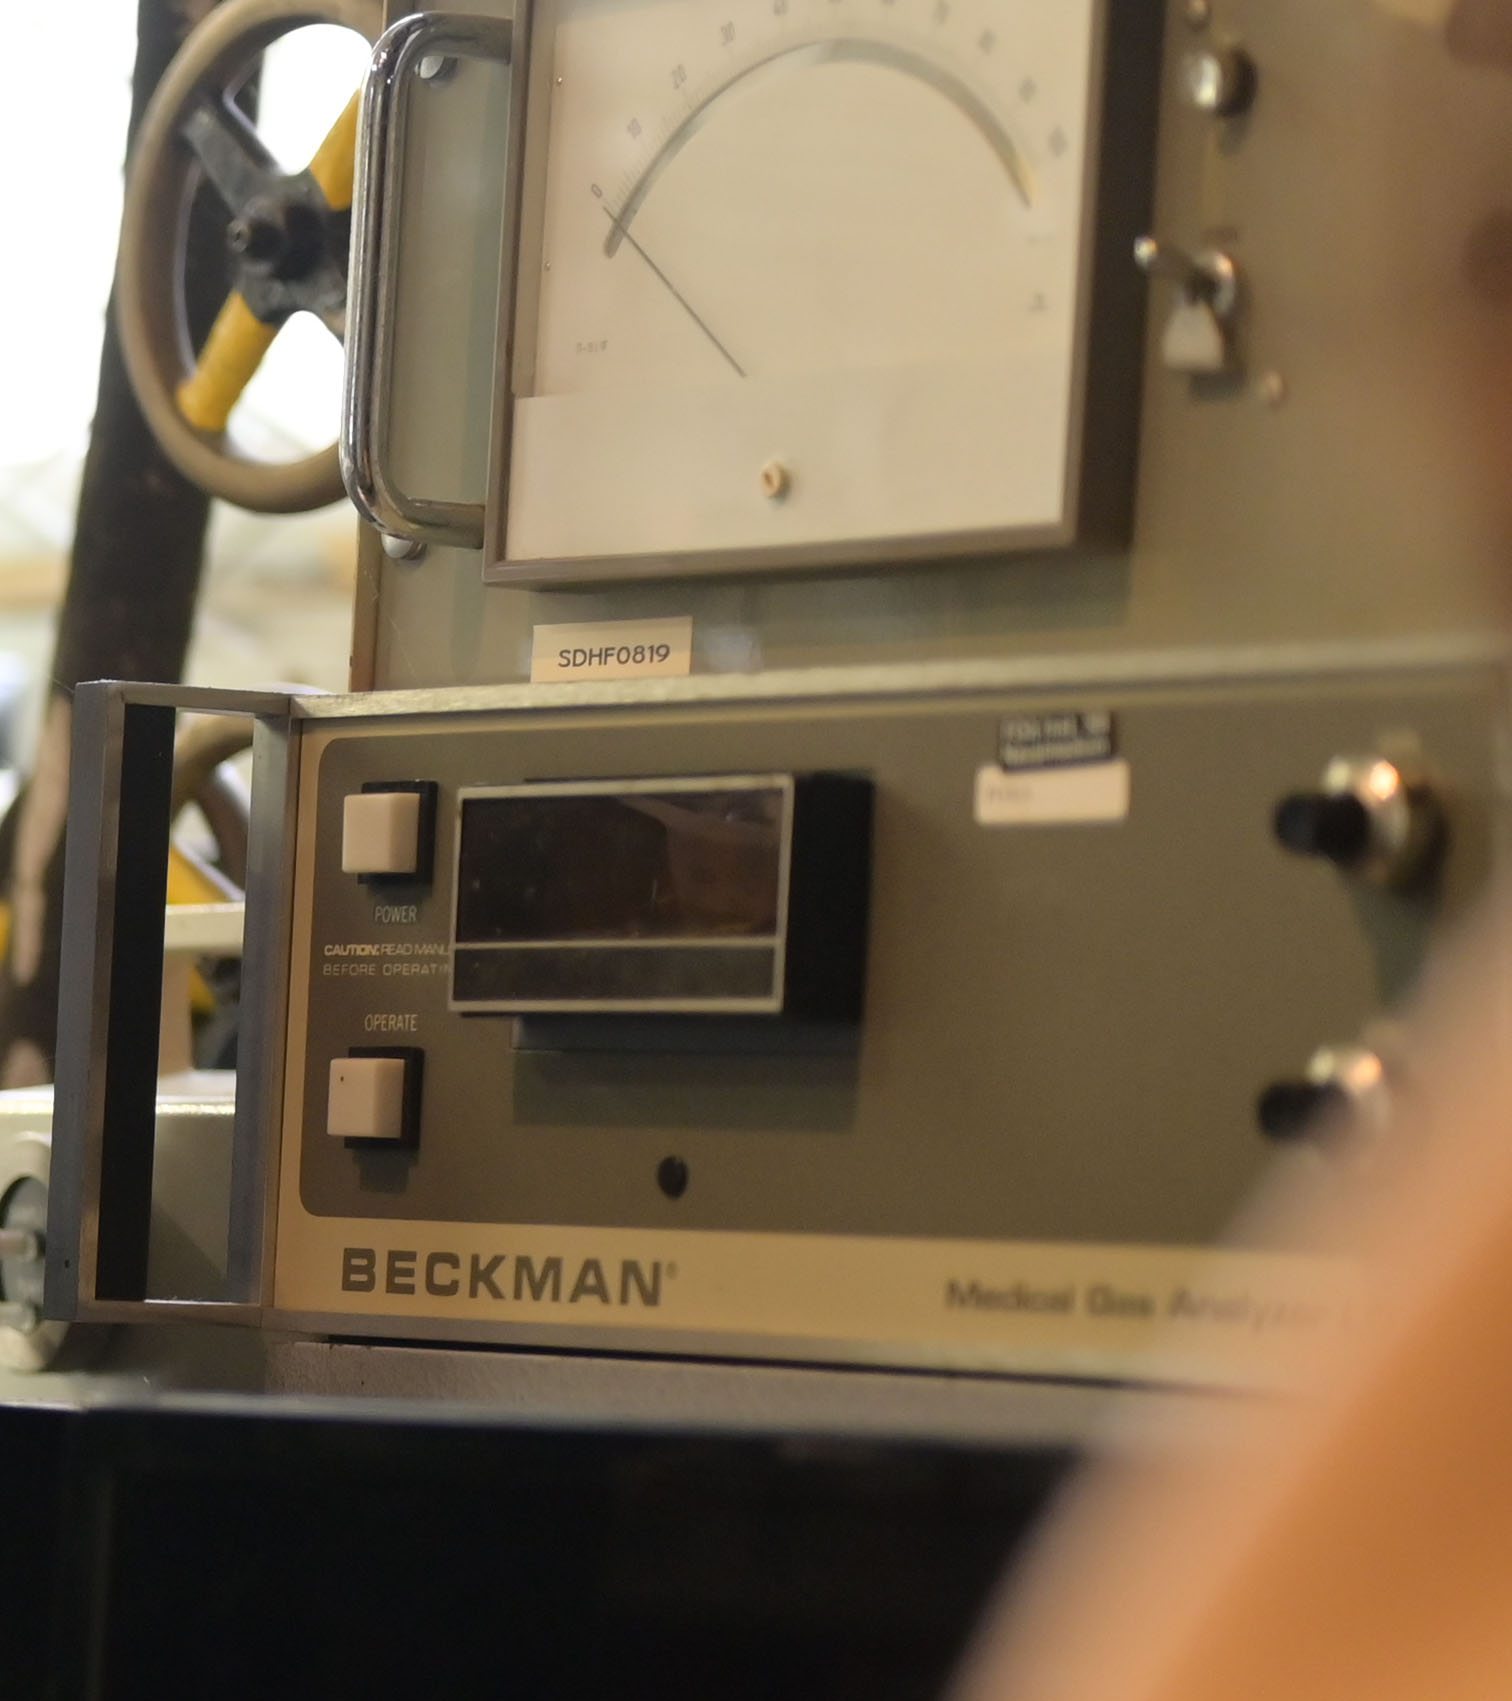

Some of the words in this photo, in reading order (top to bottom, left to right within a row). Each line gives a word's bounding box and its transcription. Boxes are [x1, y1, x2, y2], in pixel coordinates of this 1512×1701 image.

[558, 643, 671, 668] SDHF0819
[375, 905, 417, 923] POWER
[324, 944, 379, 956] CAUTION:
[381, 943, 413, 955] READ
[414, 943, 452, 955] MANU
[323, 963, 376, 976] BEFORE
[365, 1014, 418, 1031] OPERATE
[341, 1247, 662, 1306] BECKMAN
